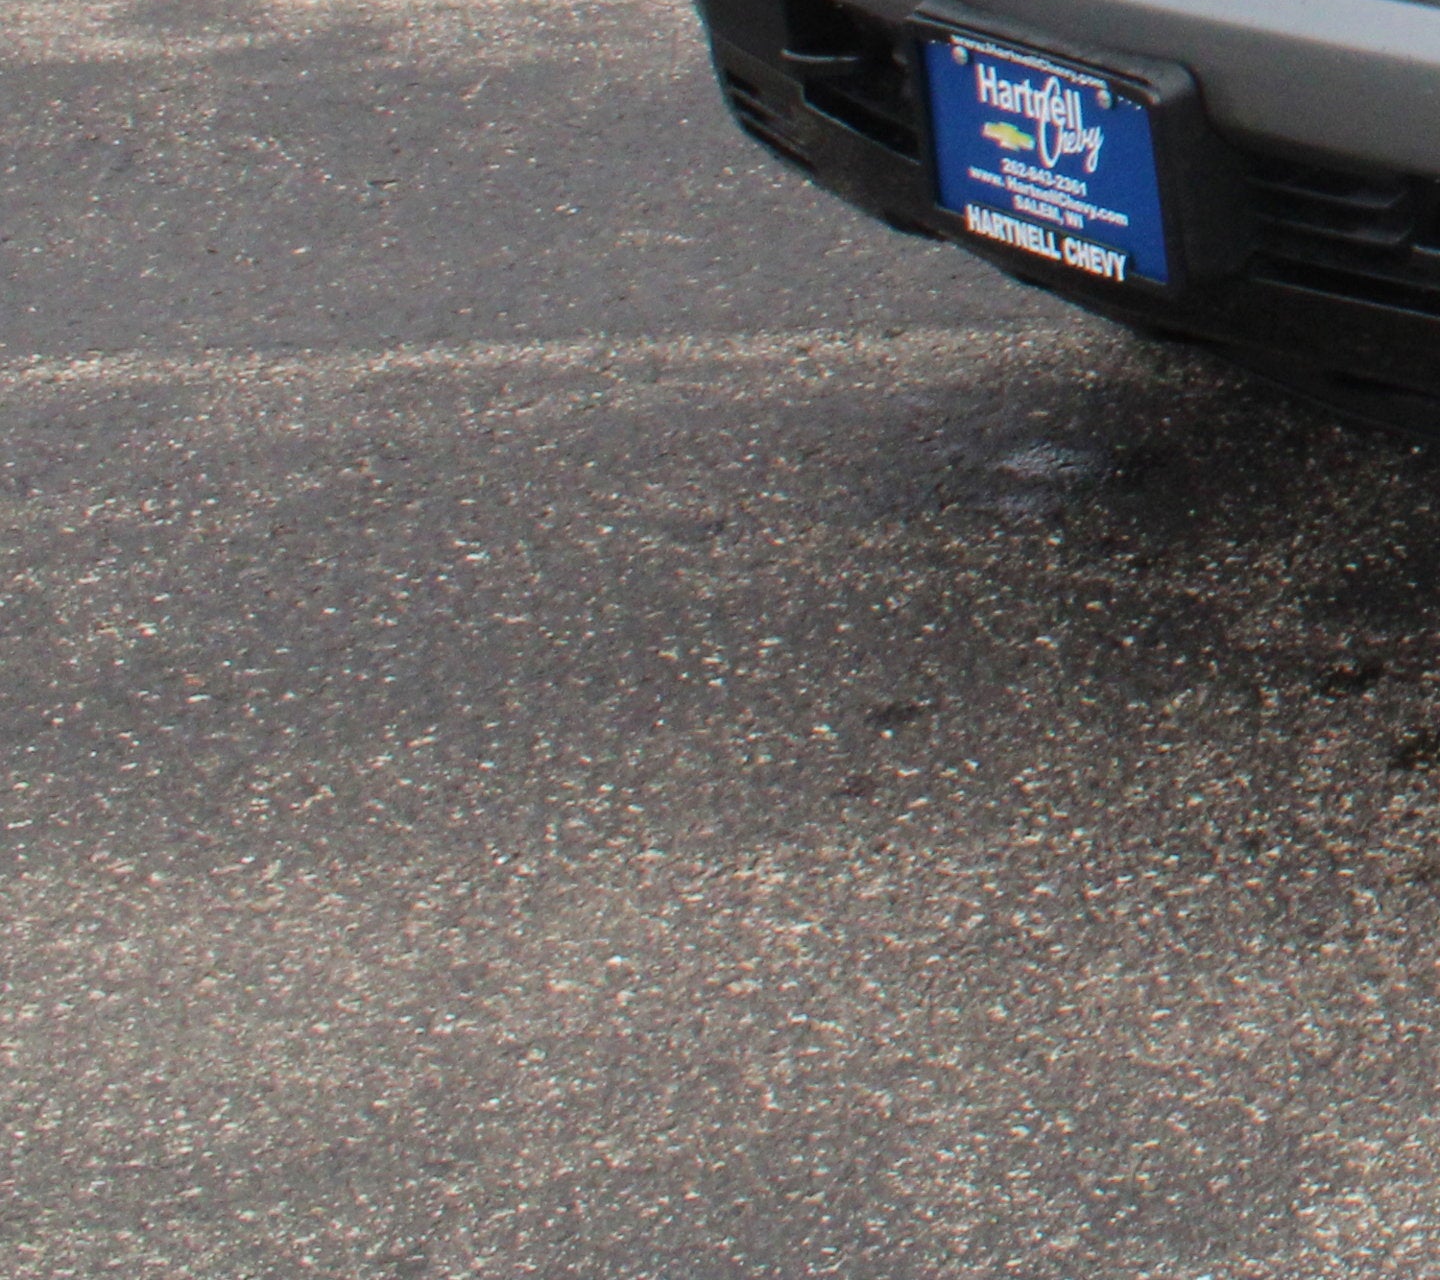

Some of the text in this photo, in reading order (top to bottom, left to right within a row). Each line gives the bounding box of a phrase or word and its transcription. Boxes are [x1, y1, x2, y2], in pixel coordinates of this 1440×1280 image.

[974, 63, 1083, 130] Hartnell
[1039, 76, 1104, 173] Chevy
[965, 204, 1127, 282] HARTNELL CHEVY
[1013, 195, 1084, 229] SALEM, WI
